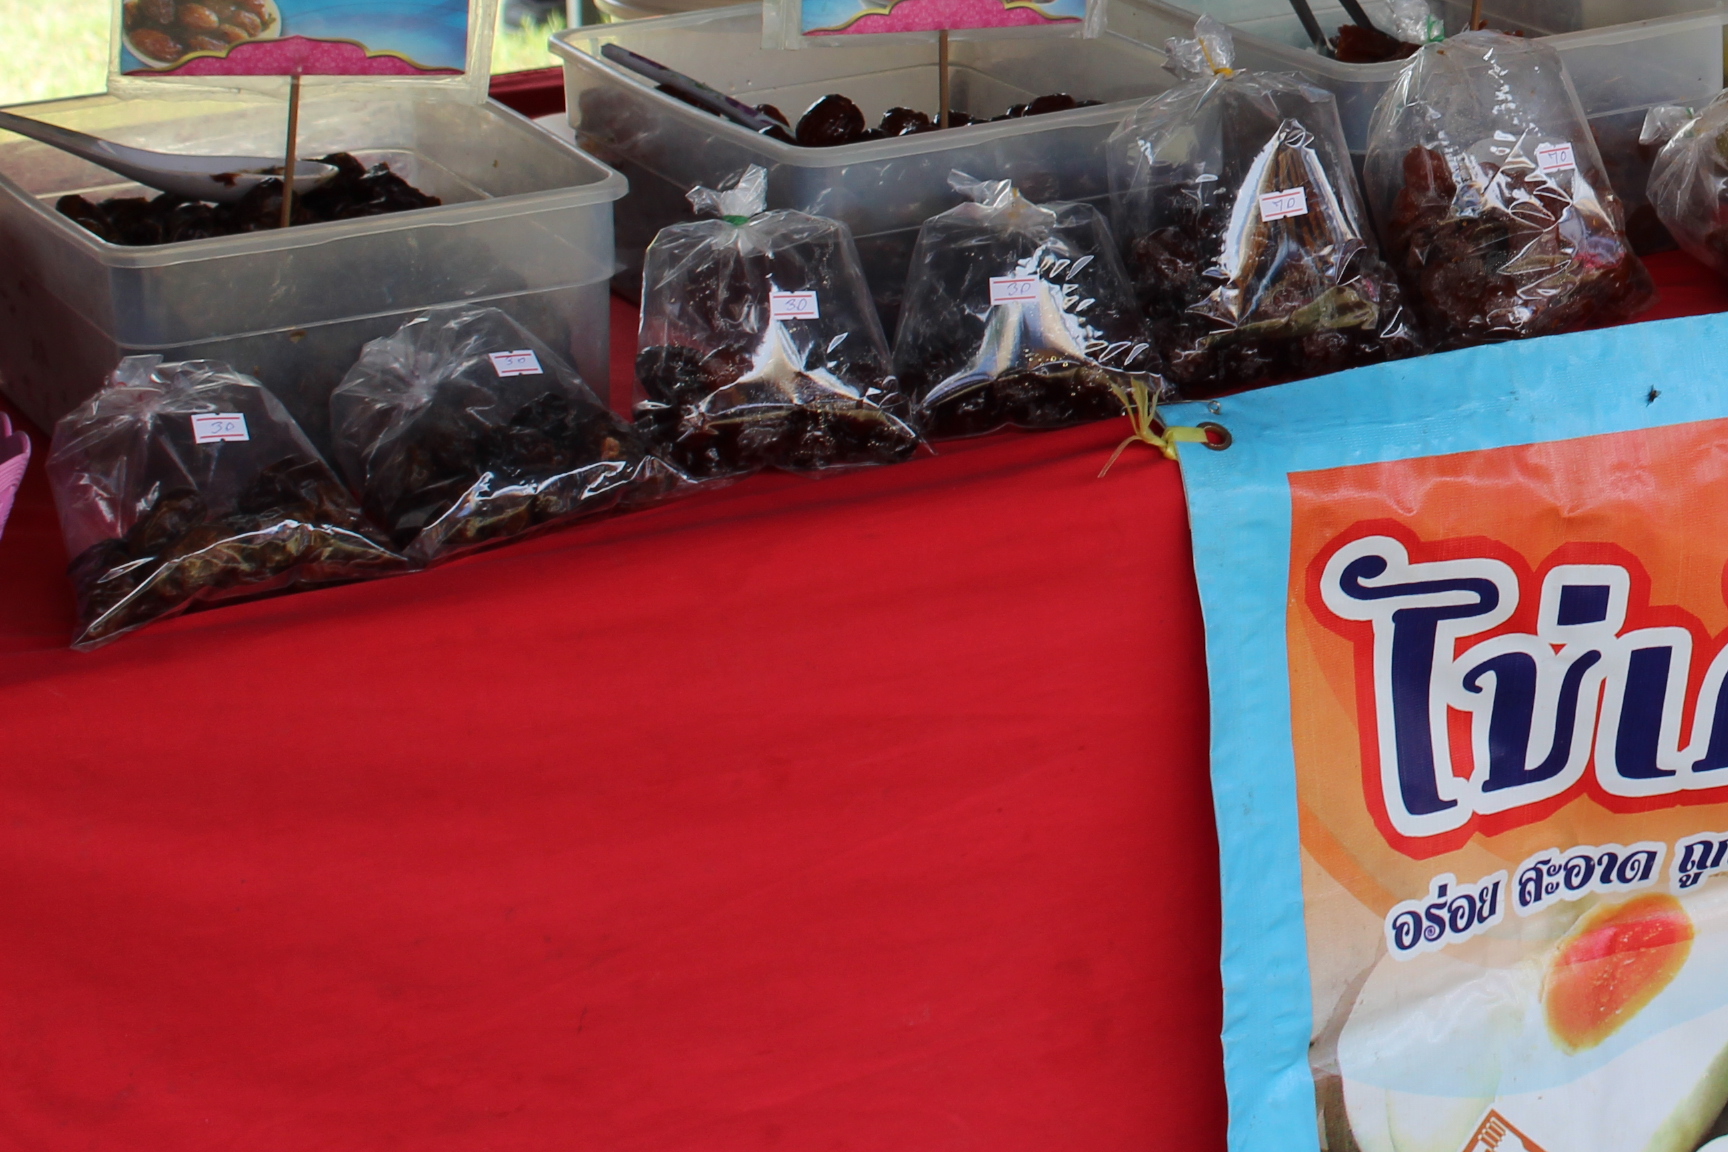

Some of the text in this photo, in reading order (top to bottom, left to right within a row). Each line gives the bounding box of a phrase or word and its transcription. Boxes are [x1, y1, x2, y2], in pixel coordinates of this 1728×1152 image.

[1006, 282, 1031, 296] 30
[785, 298, 807, 311] 30
[211, 421, 236, 435] 30
[1392, 882, 1500, 952] อร่อย
[1518, 846, 1657, 908] สะอาด
